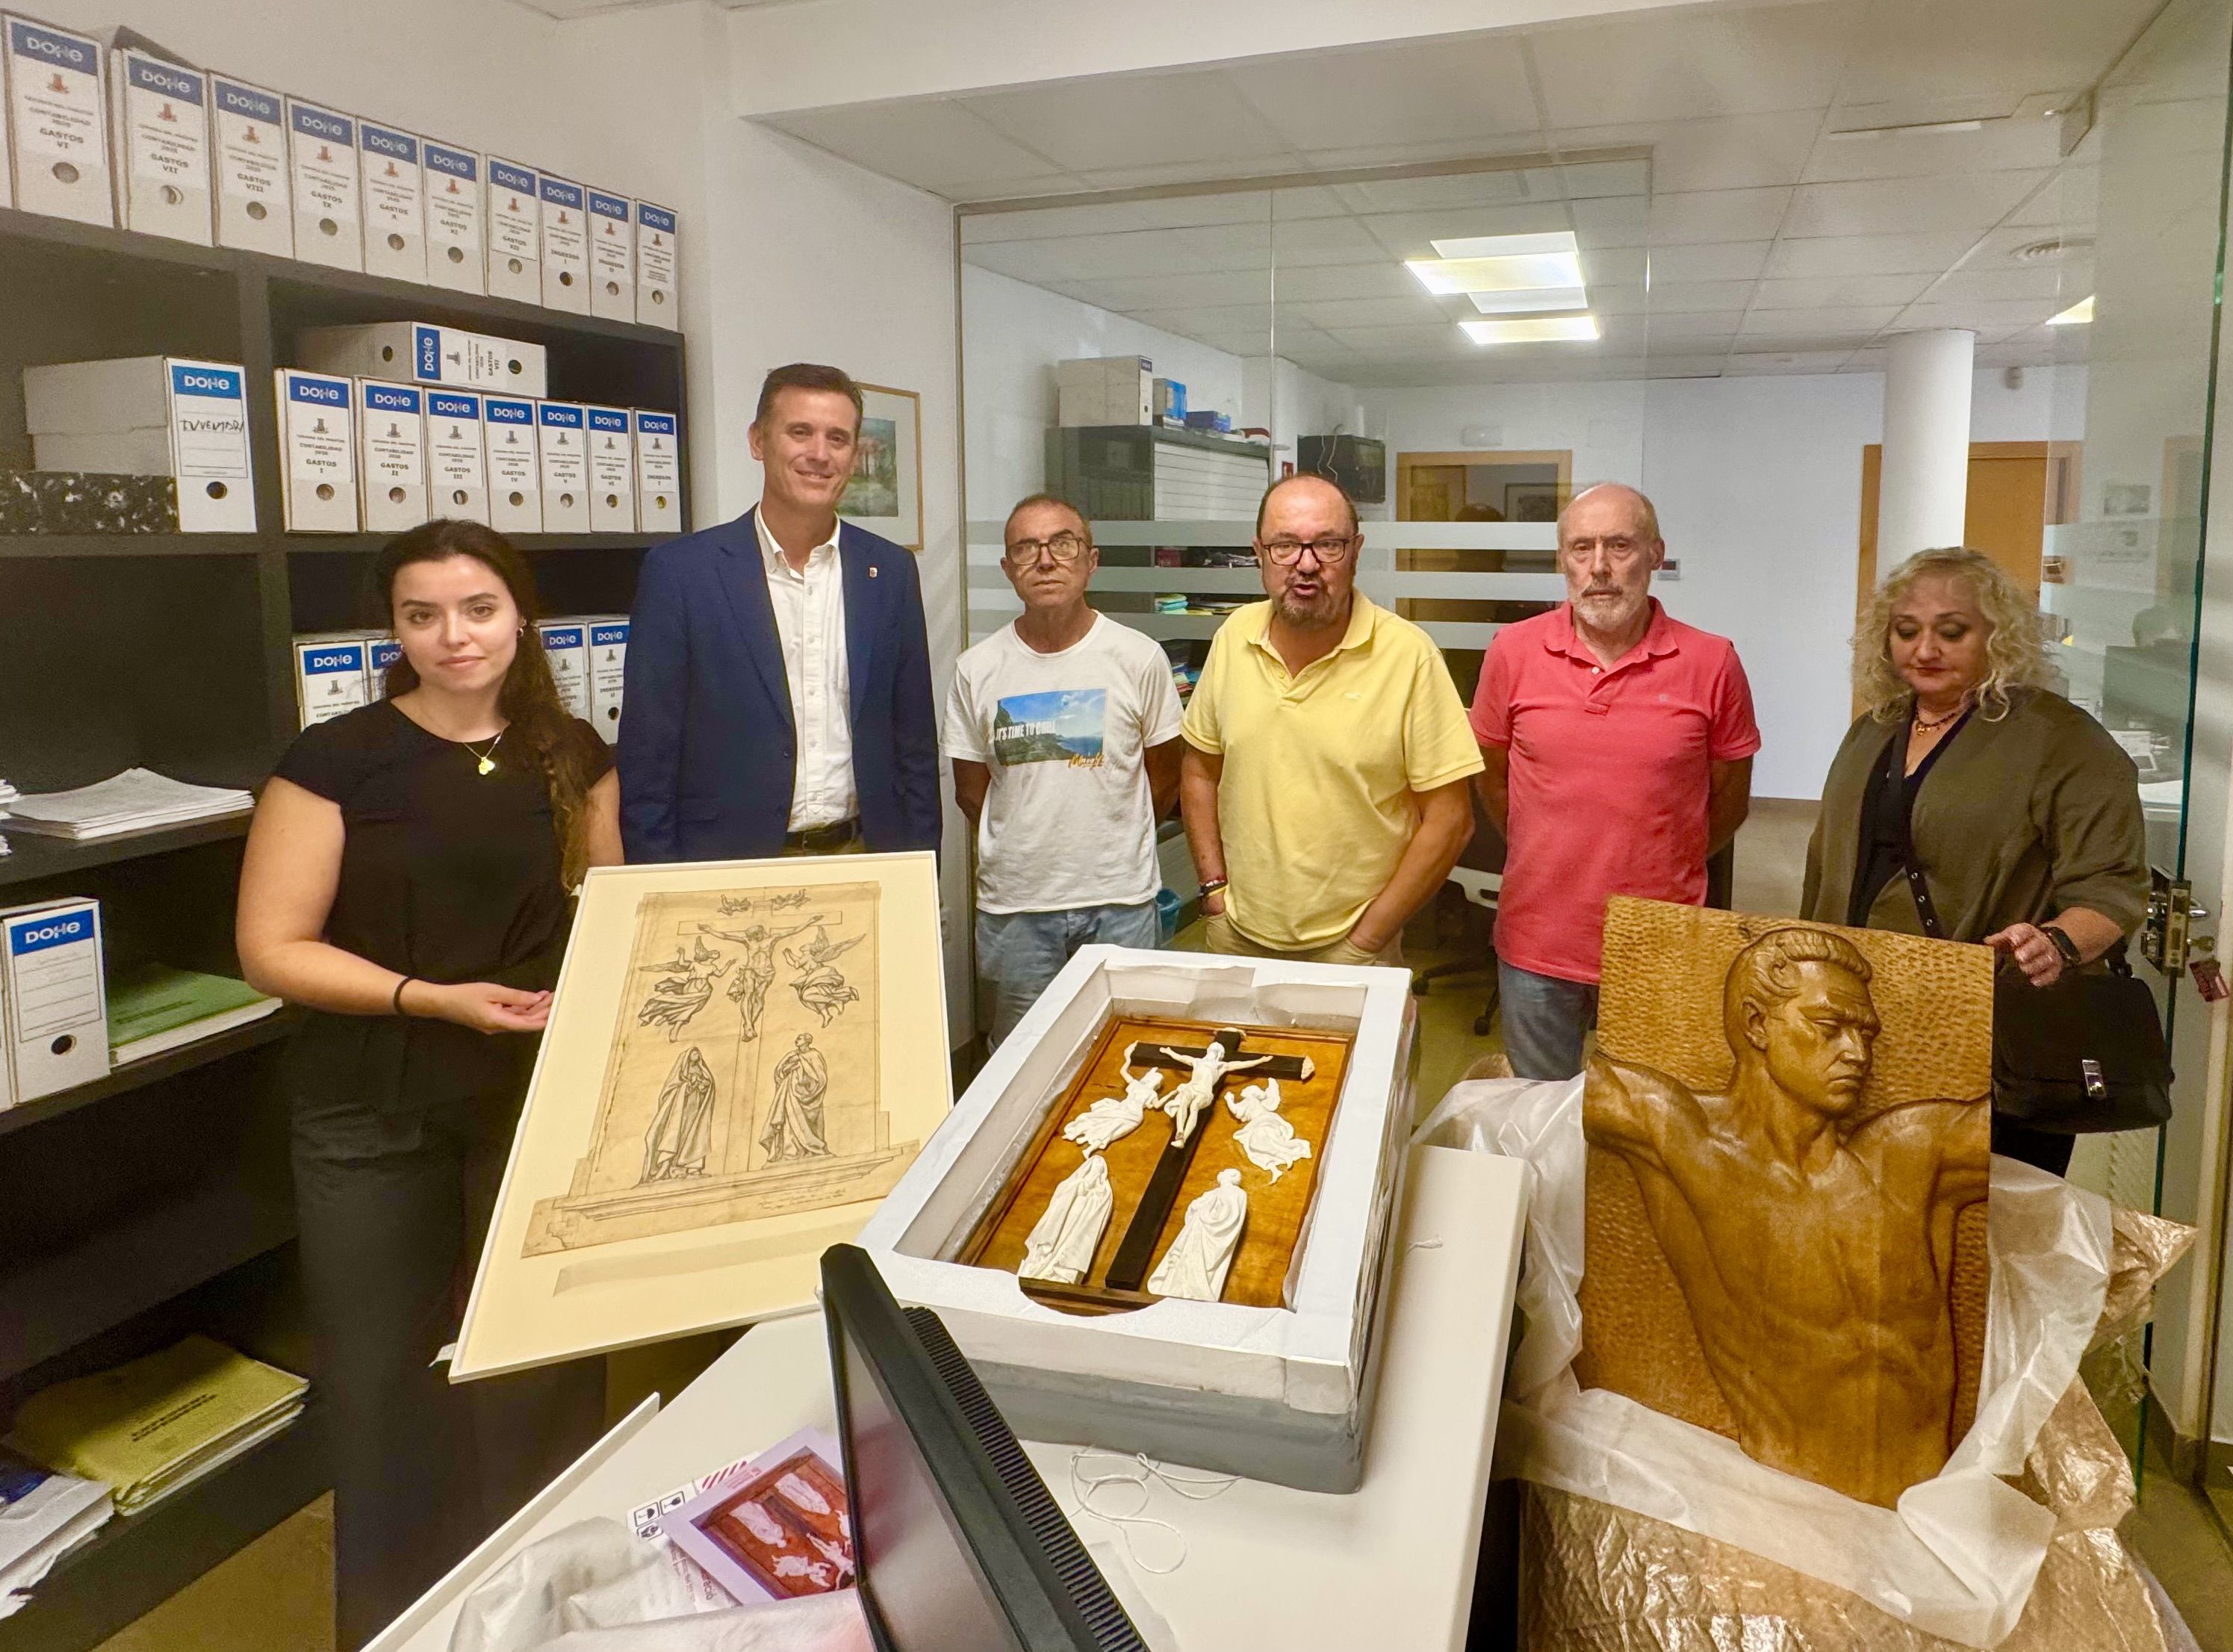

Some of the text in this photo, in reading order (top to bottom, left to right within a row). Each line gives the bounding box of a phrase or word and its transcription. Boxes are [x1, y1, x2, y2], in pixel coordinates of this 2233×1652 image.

[40, 127, 84, 143] GASTOS
[57, 141, 69, 149] VI
[151, 153, 189, 168] GASTOS
[162, 165, 178, 174] VII
[237, 173, 271, 186] GASTOS
[311, 190, 343, 204] GASTOS
[379, 203, 409, 215] GASTOS
[440, 219, 468, 231] GASTOS
[502, 236, 527, 246] GASTOS
[306, 459, 337, 468] GASTOS
[996, 727, 1007, 742] IT'S
[1007, 724, 1025, 739] TIME
[1025, 722, 1035, 736] TO
